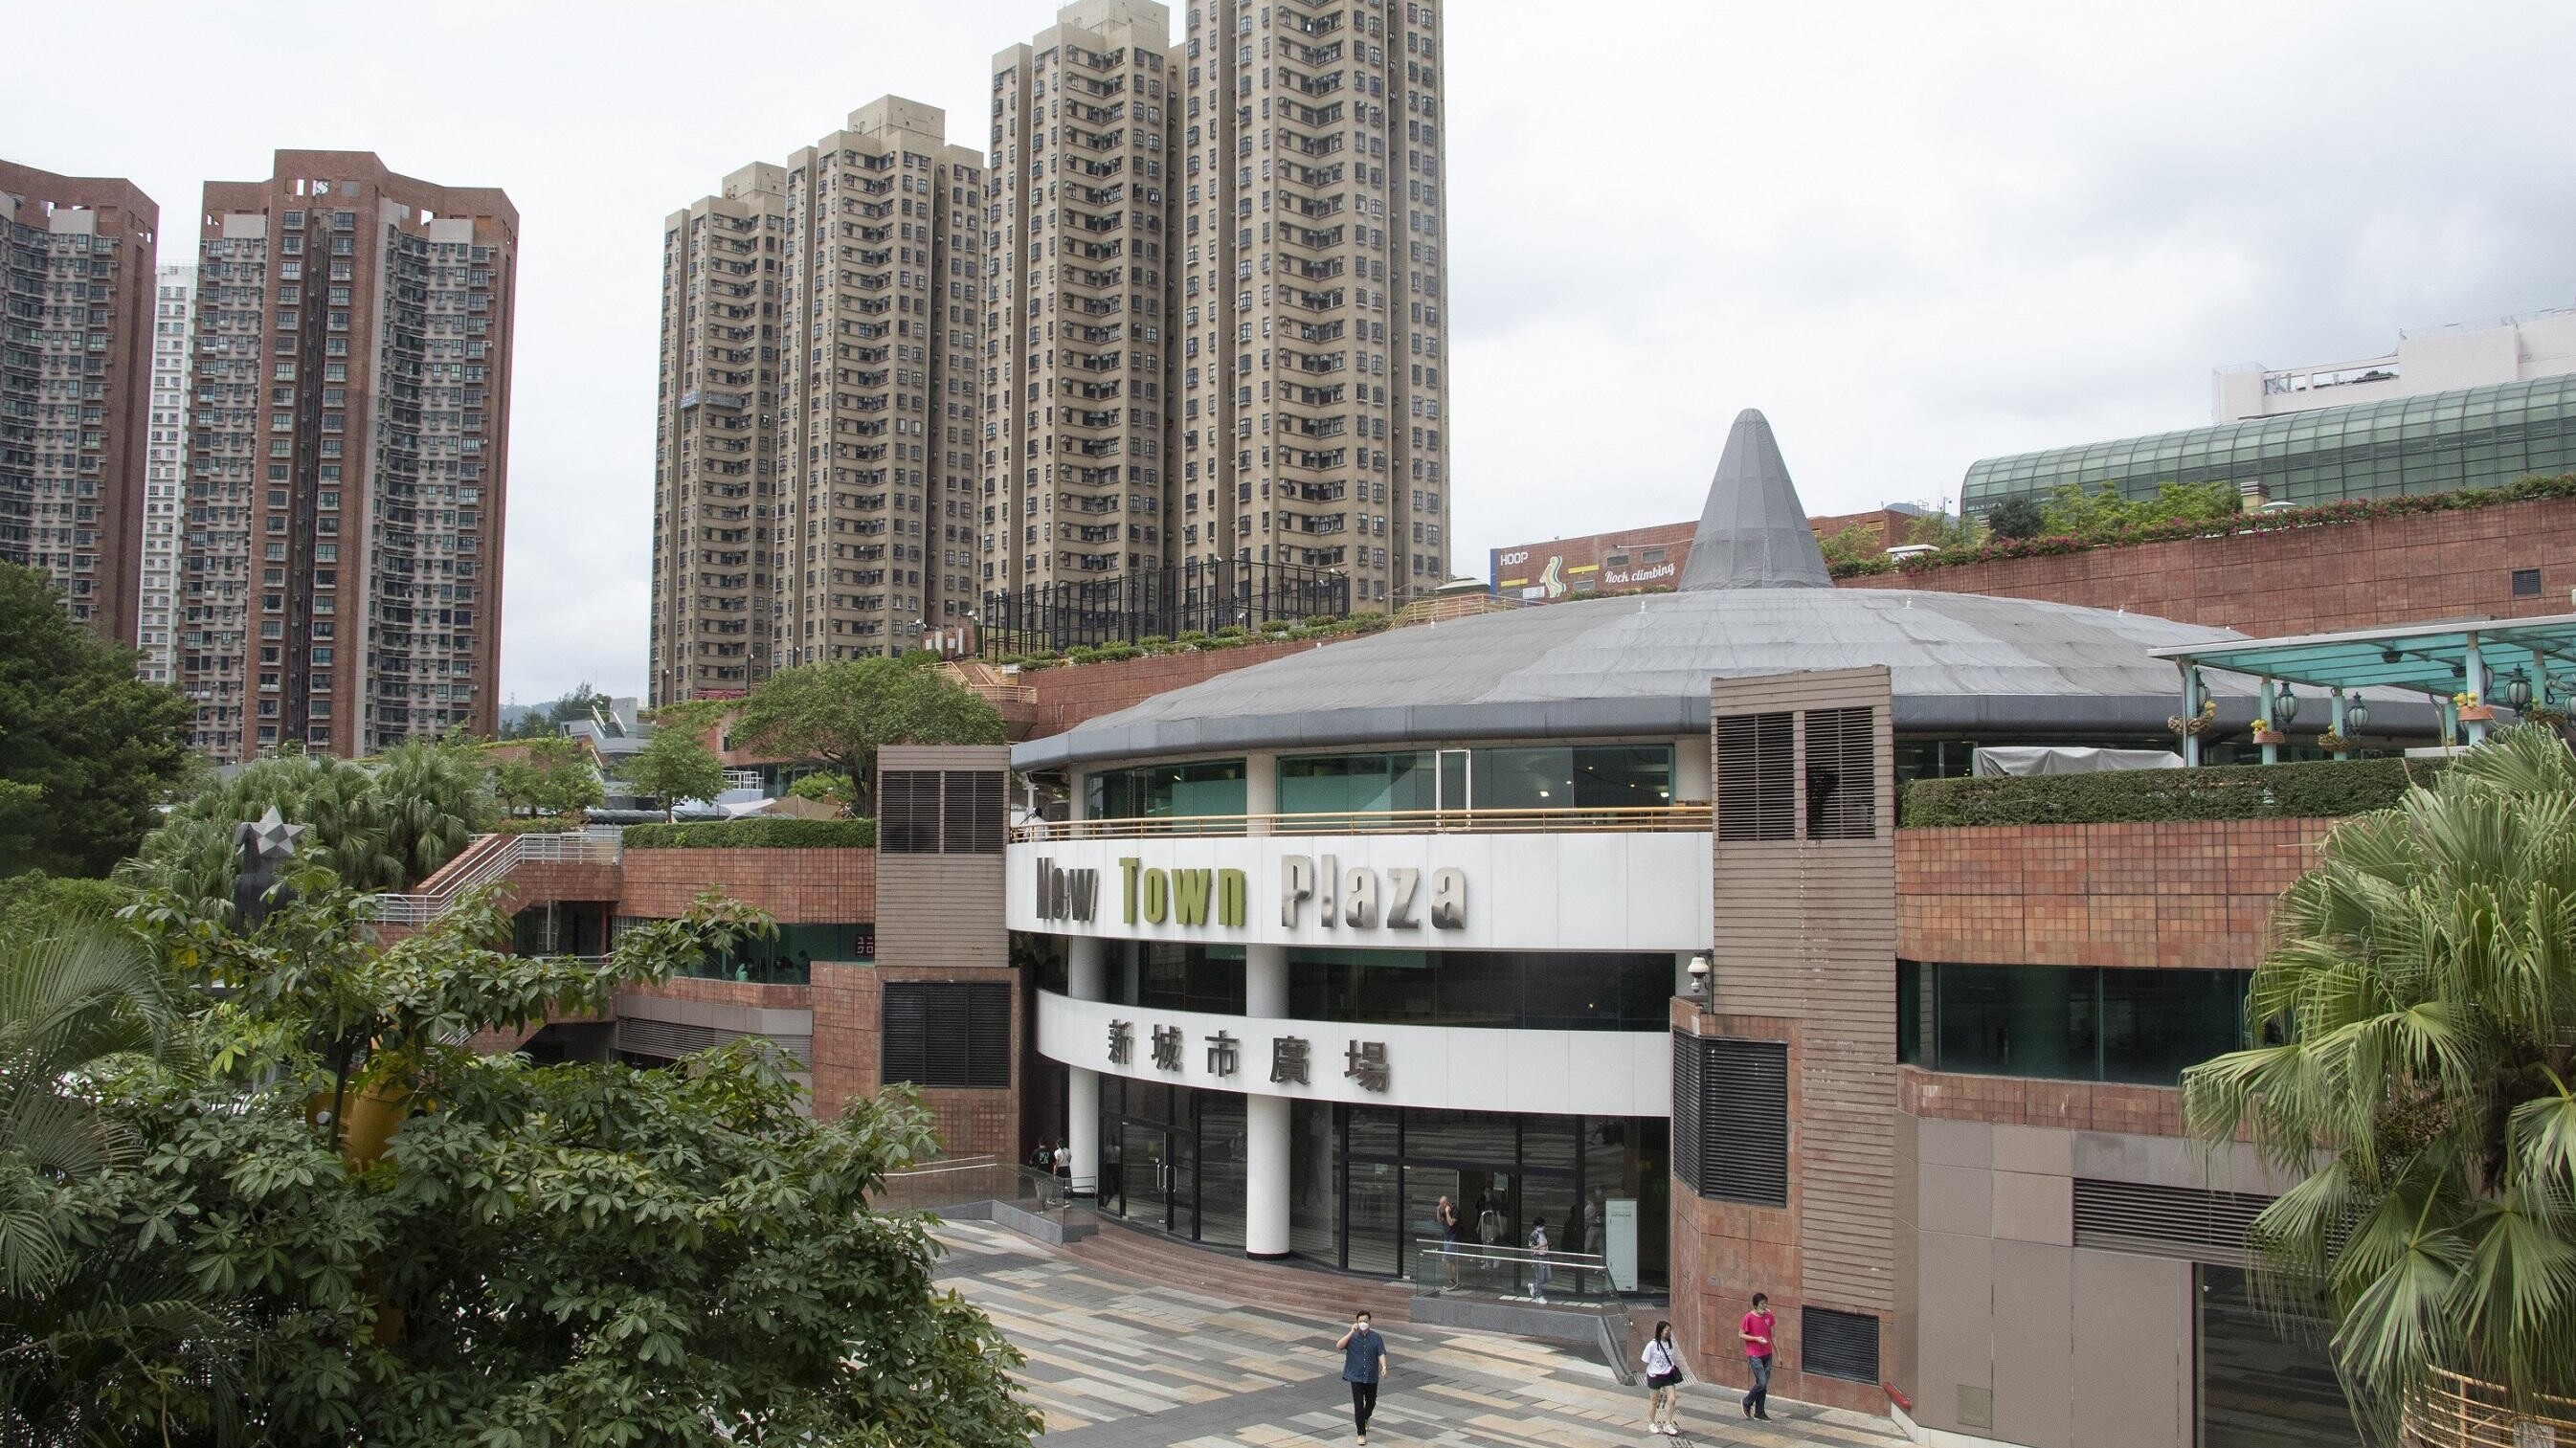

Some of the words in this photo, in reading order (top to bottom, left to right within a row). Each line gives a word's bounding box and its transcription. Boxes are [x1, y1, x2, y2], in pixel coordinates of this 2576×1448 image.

[1500, 551, 1529, 566] HOOP
[1604, 570, 1629, 584] Rock
[1631, 563, 1674, 582] climbing
[1036, 857, 1098, 922] New
[1118, 857, 1247, 925] Town
[1281, 854, 1467, 930] Plaza
[1108, 1018, 1391, 1093] 新城市廣場
